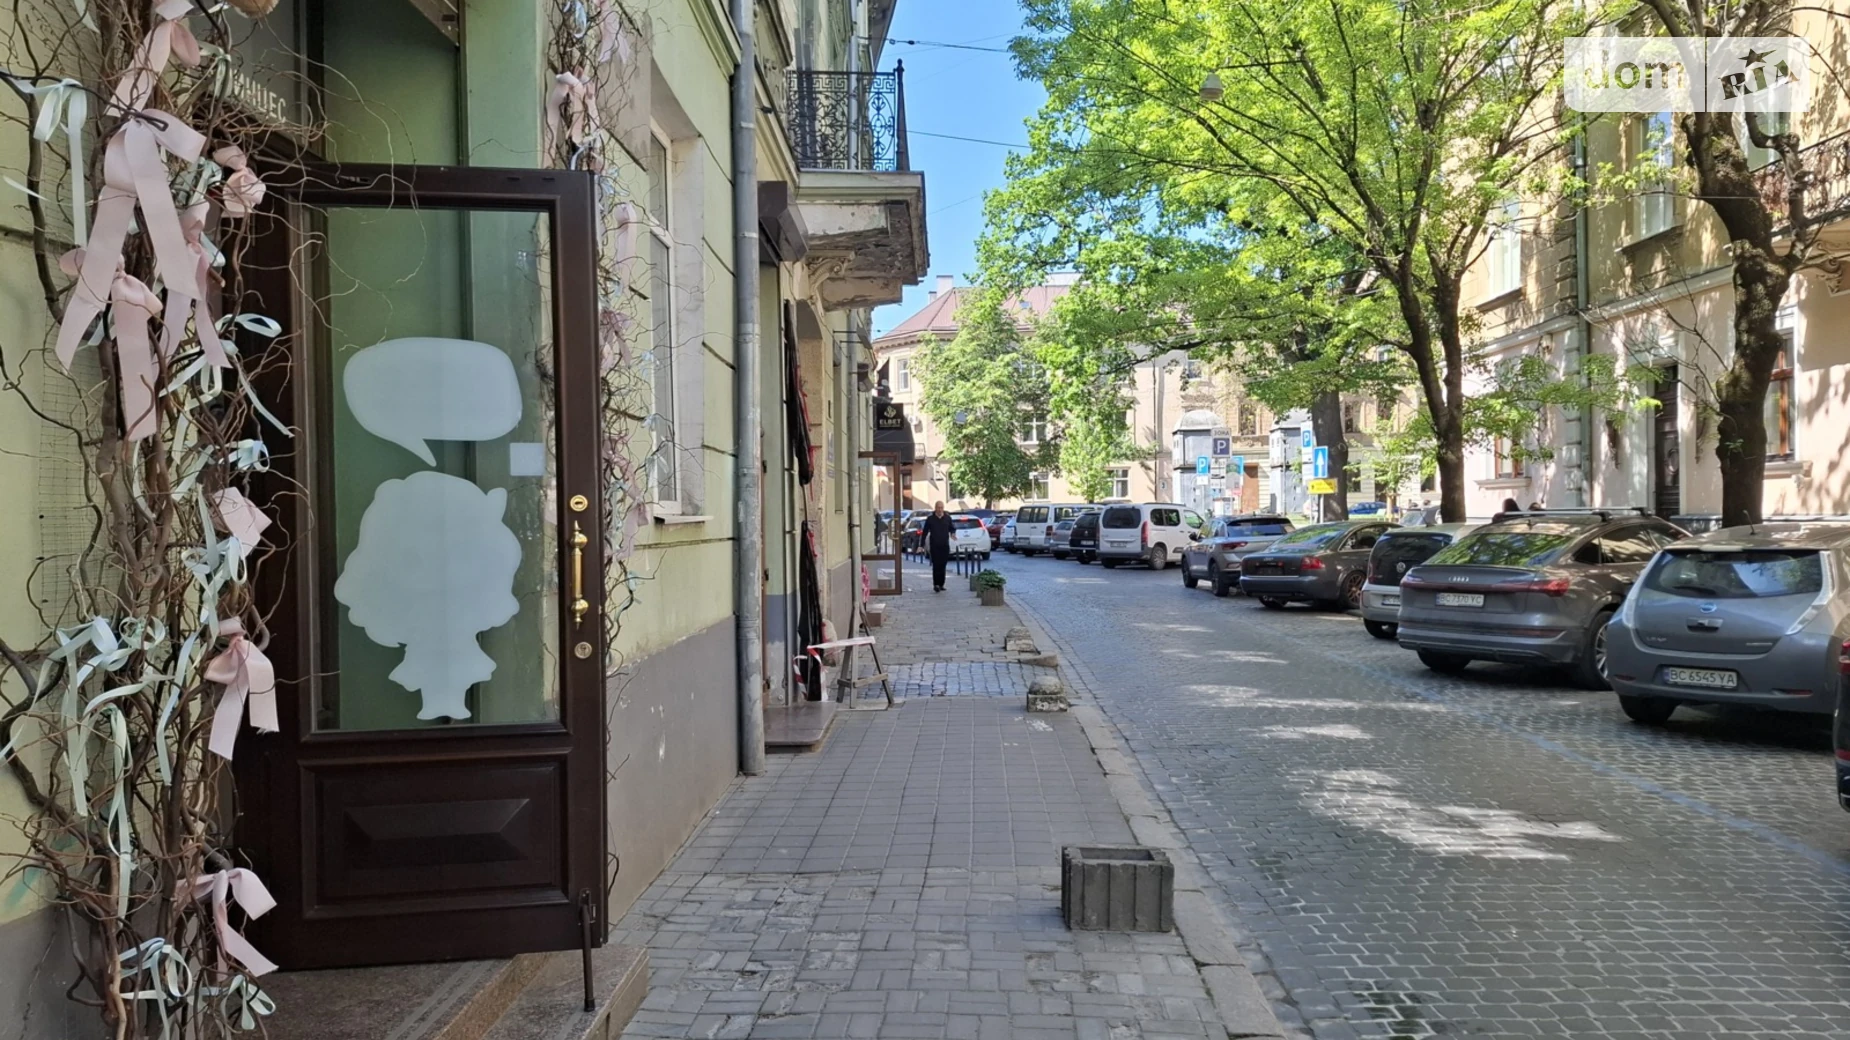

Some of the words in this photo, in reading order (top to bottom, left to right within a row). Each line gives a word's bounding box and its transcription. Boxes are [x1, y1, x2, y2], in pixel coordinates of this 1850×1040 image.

[1670, 669, 1687, 681] BC
[1688, 671, 1717, 683] 6545
[1718, 673, 1735, 685] YA
